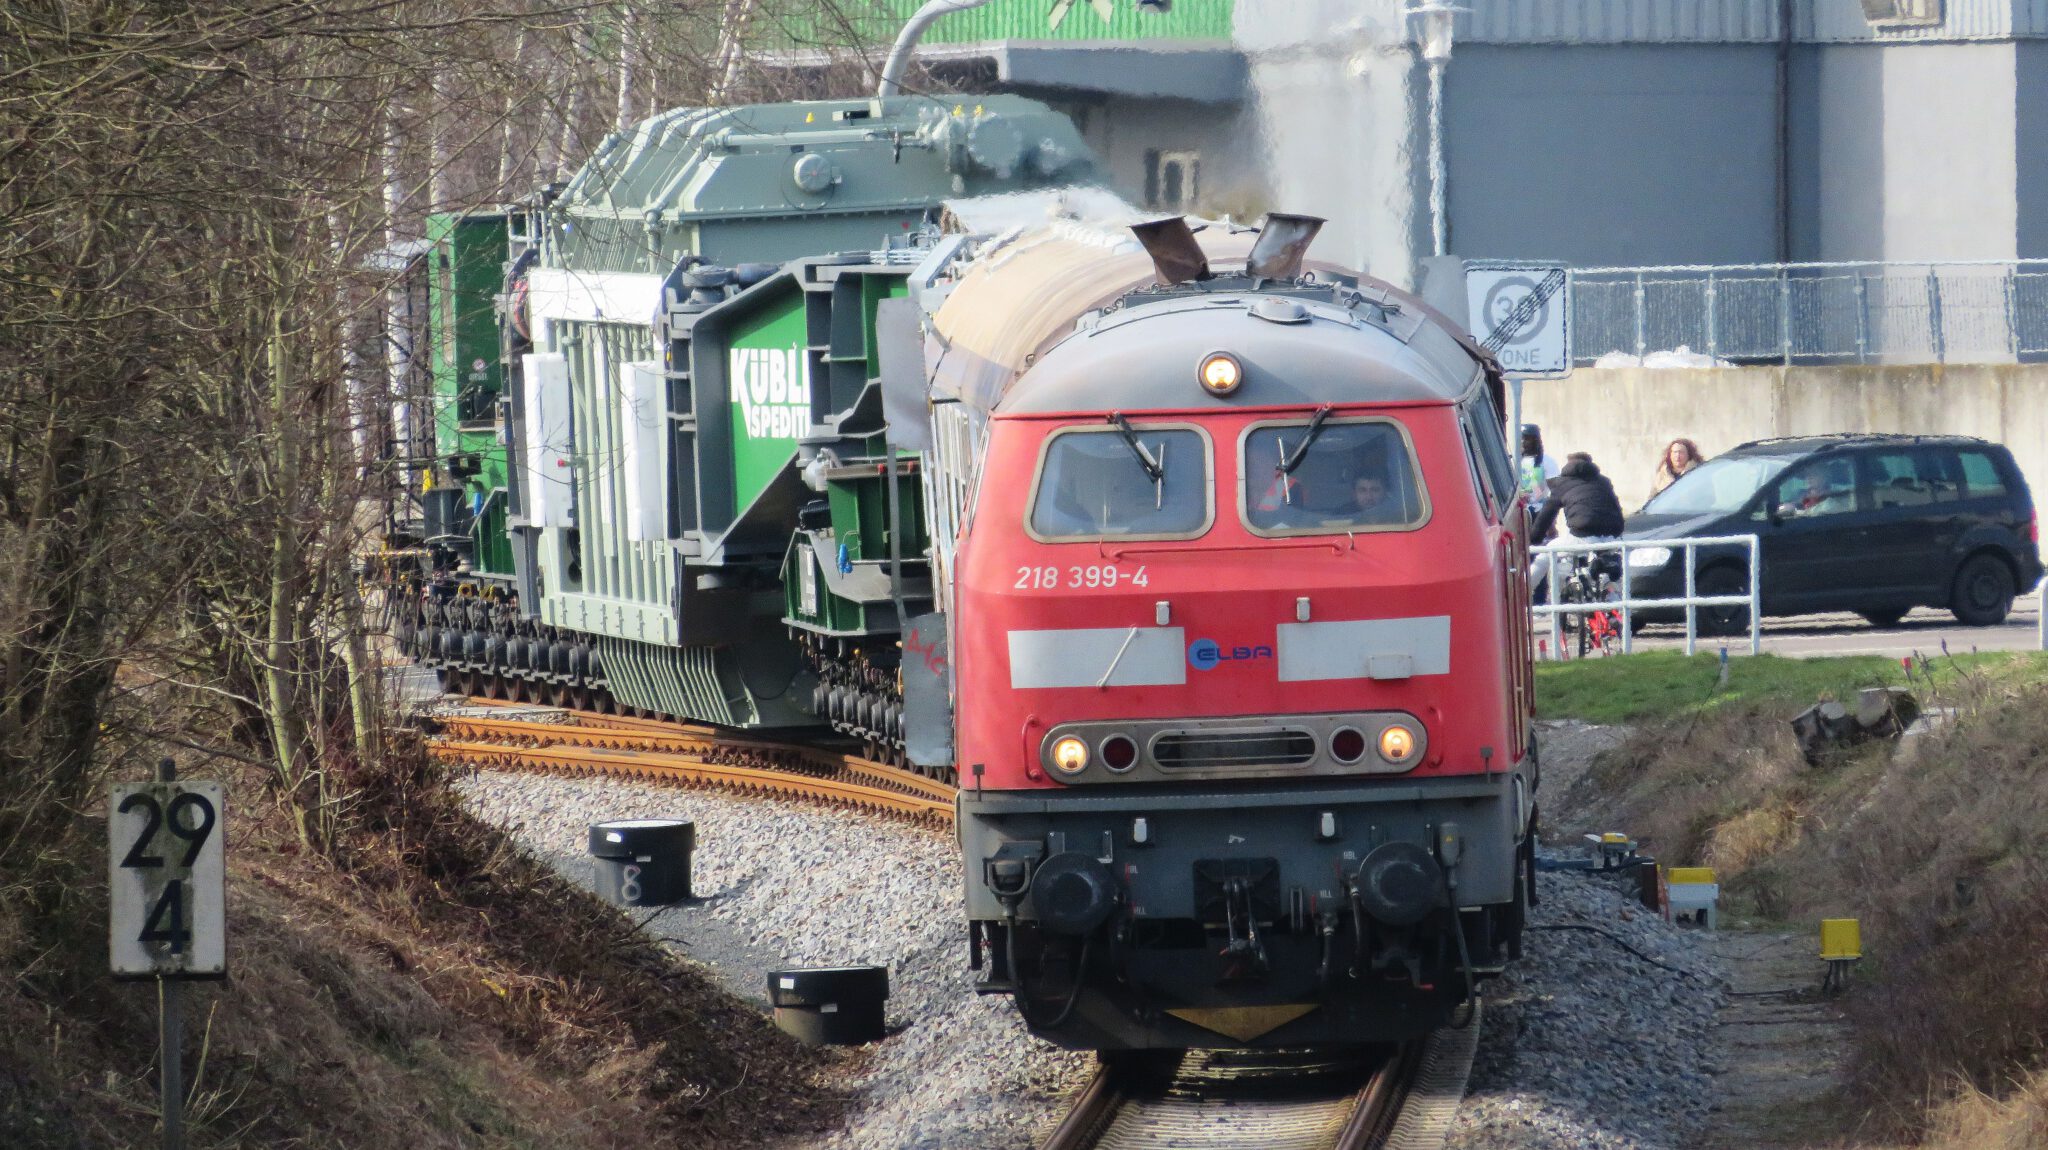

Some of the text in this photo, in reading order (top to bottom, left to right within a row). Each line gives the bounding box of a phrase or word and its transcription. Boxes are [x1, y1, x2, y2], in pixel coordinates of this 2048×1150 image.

[1499, 347, 1541, 365] ONE
[1014, 565, 1148, 589] 218 399-4
[1196, 645, 1272, 661] ELBA
[117, 792, 216, 868] 29
[621, 864, 642, 901] 8
[137, 878, 192, 955] 4
